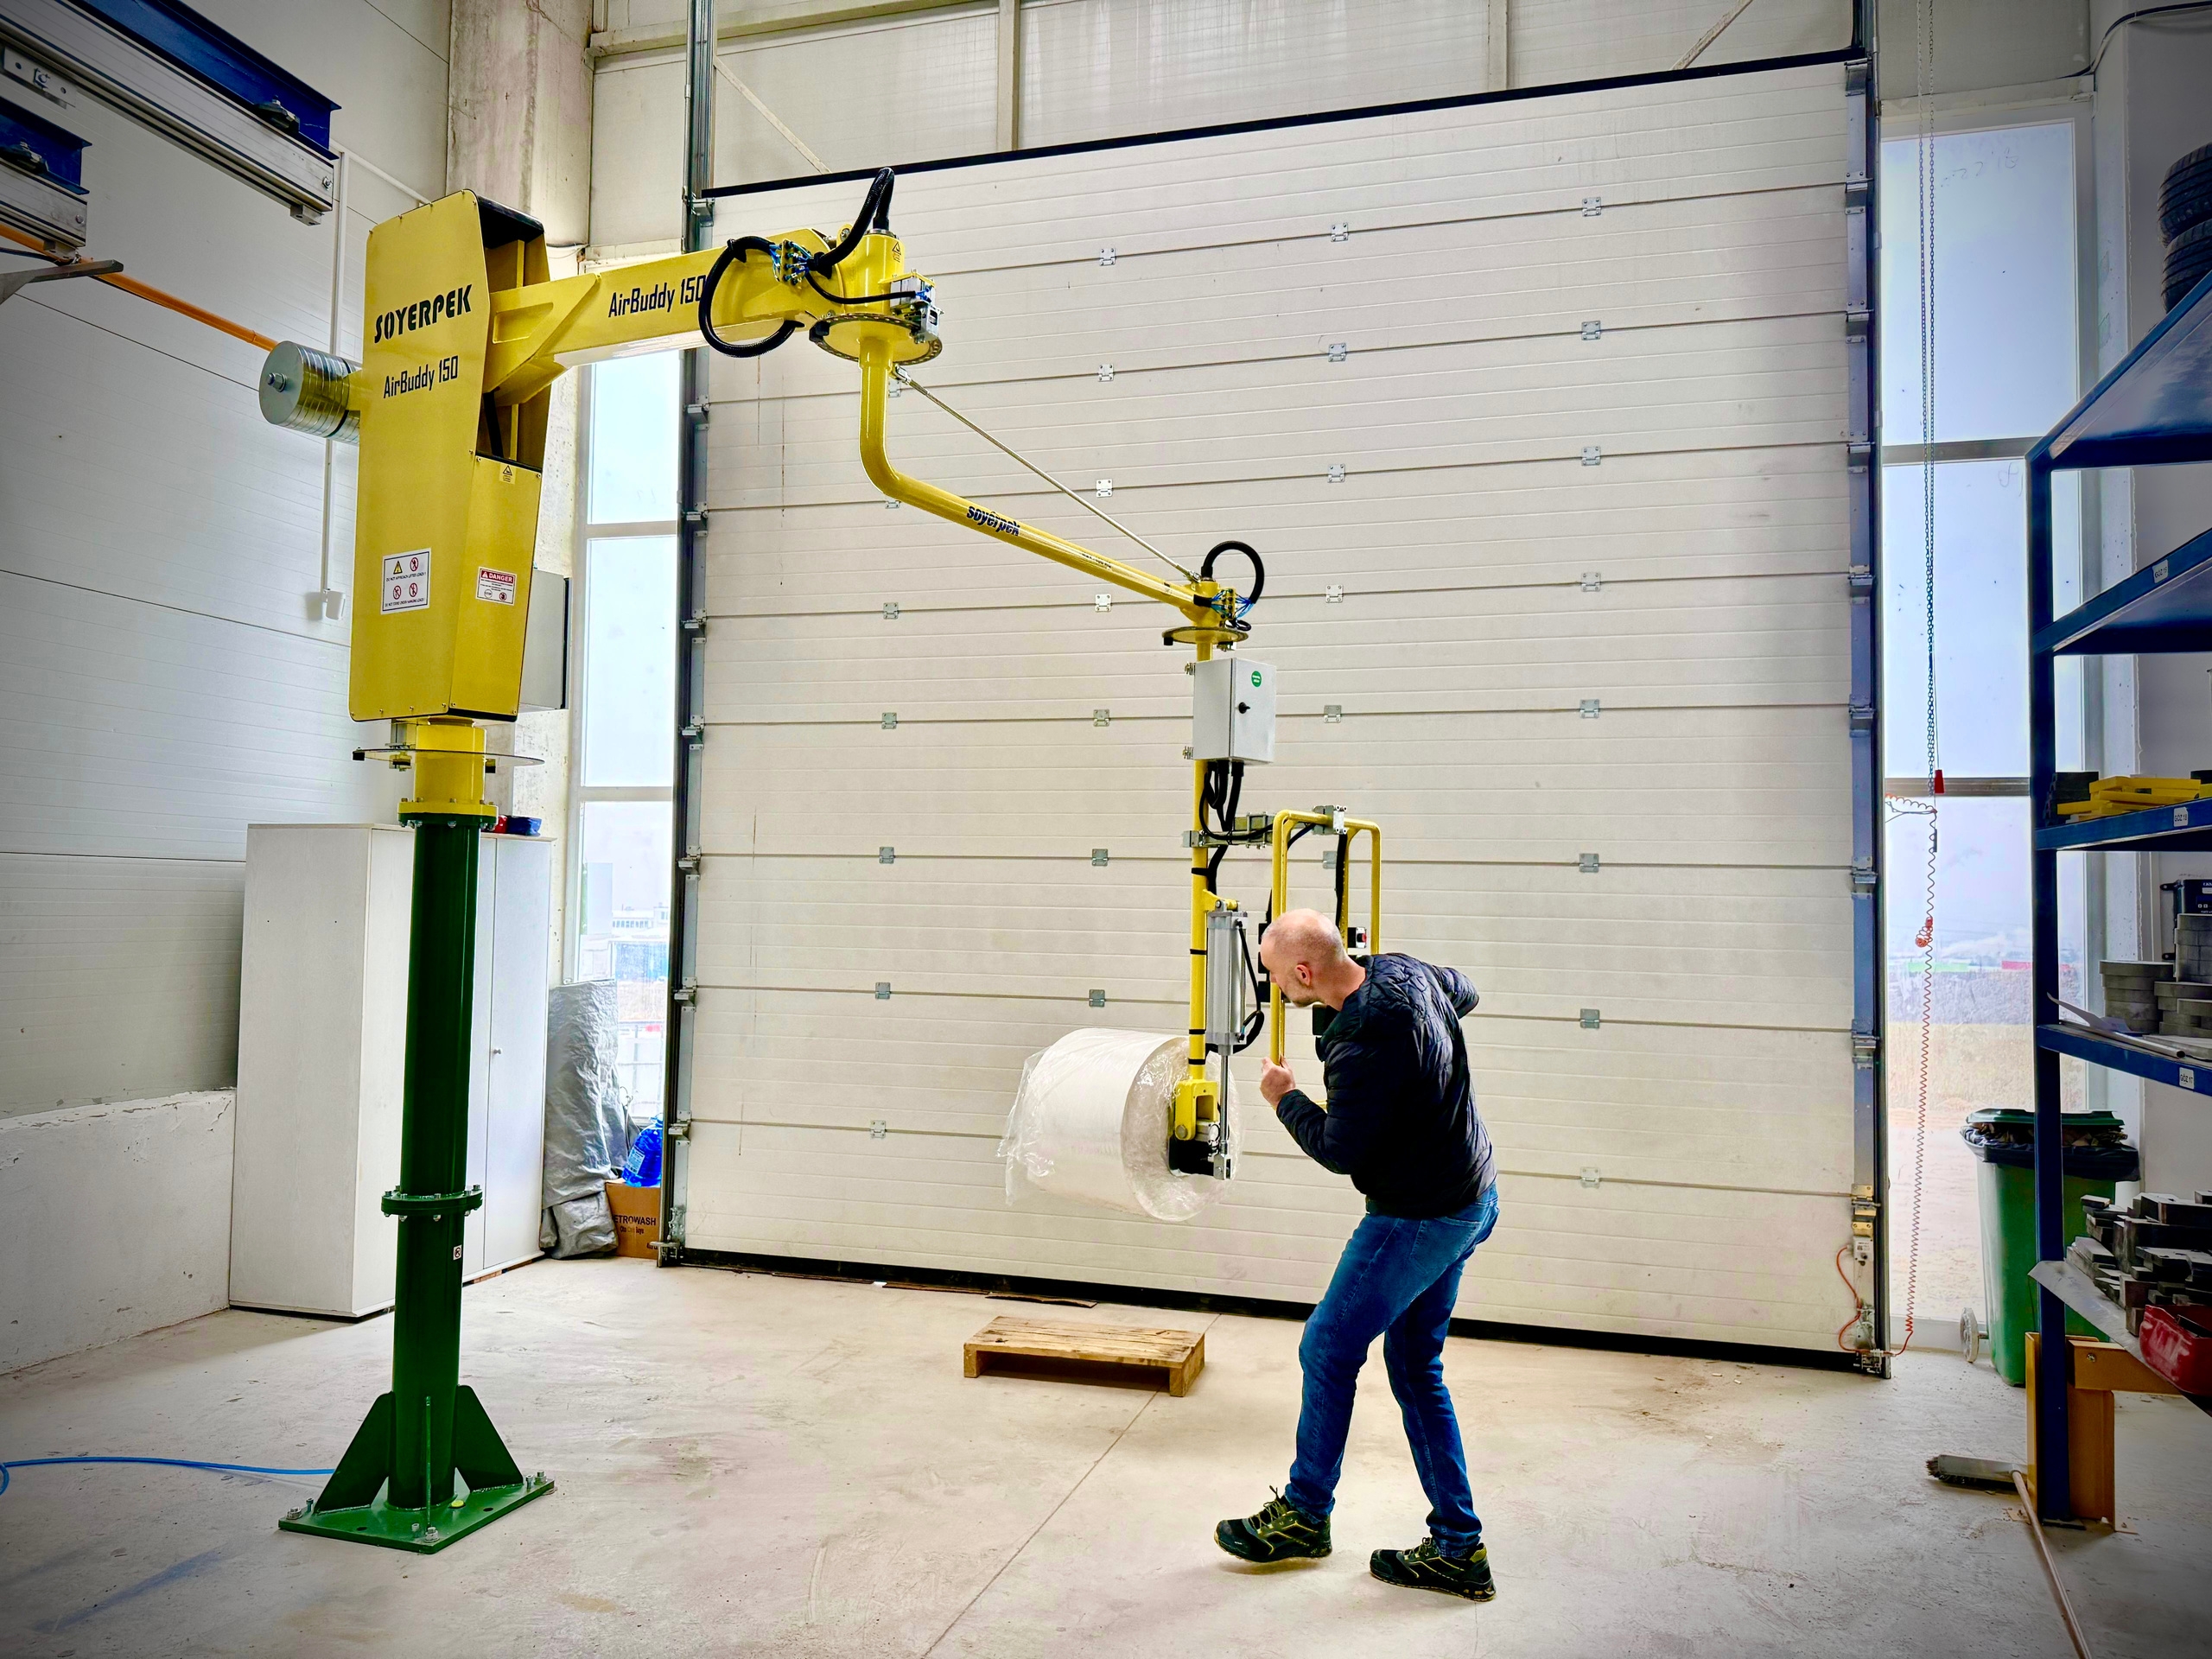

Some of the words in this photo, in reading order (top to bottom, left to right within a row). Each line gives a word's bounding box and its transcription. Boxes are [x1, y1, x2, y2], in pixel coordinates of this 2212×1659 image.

[374, 283, 473, 344] SOYERPEK
[608, 282, 676, 318] AirBuddy
[680, 275, 706, 304] 150
[383, 363, 435, 398] AirBuddy
[438, 355, 459, 383] 150
[488, 572, 512, 583] DANGER
[613, 1215, 656, 1226] ETROWASH
